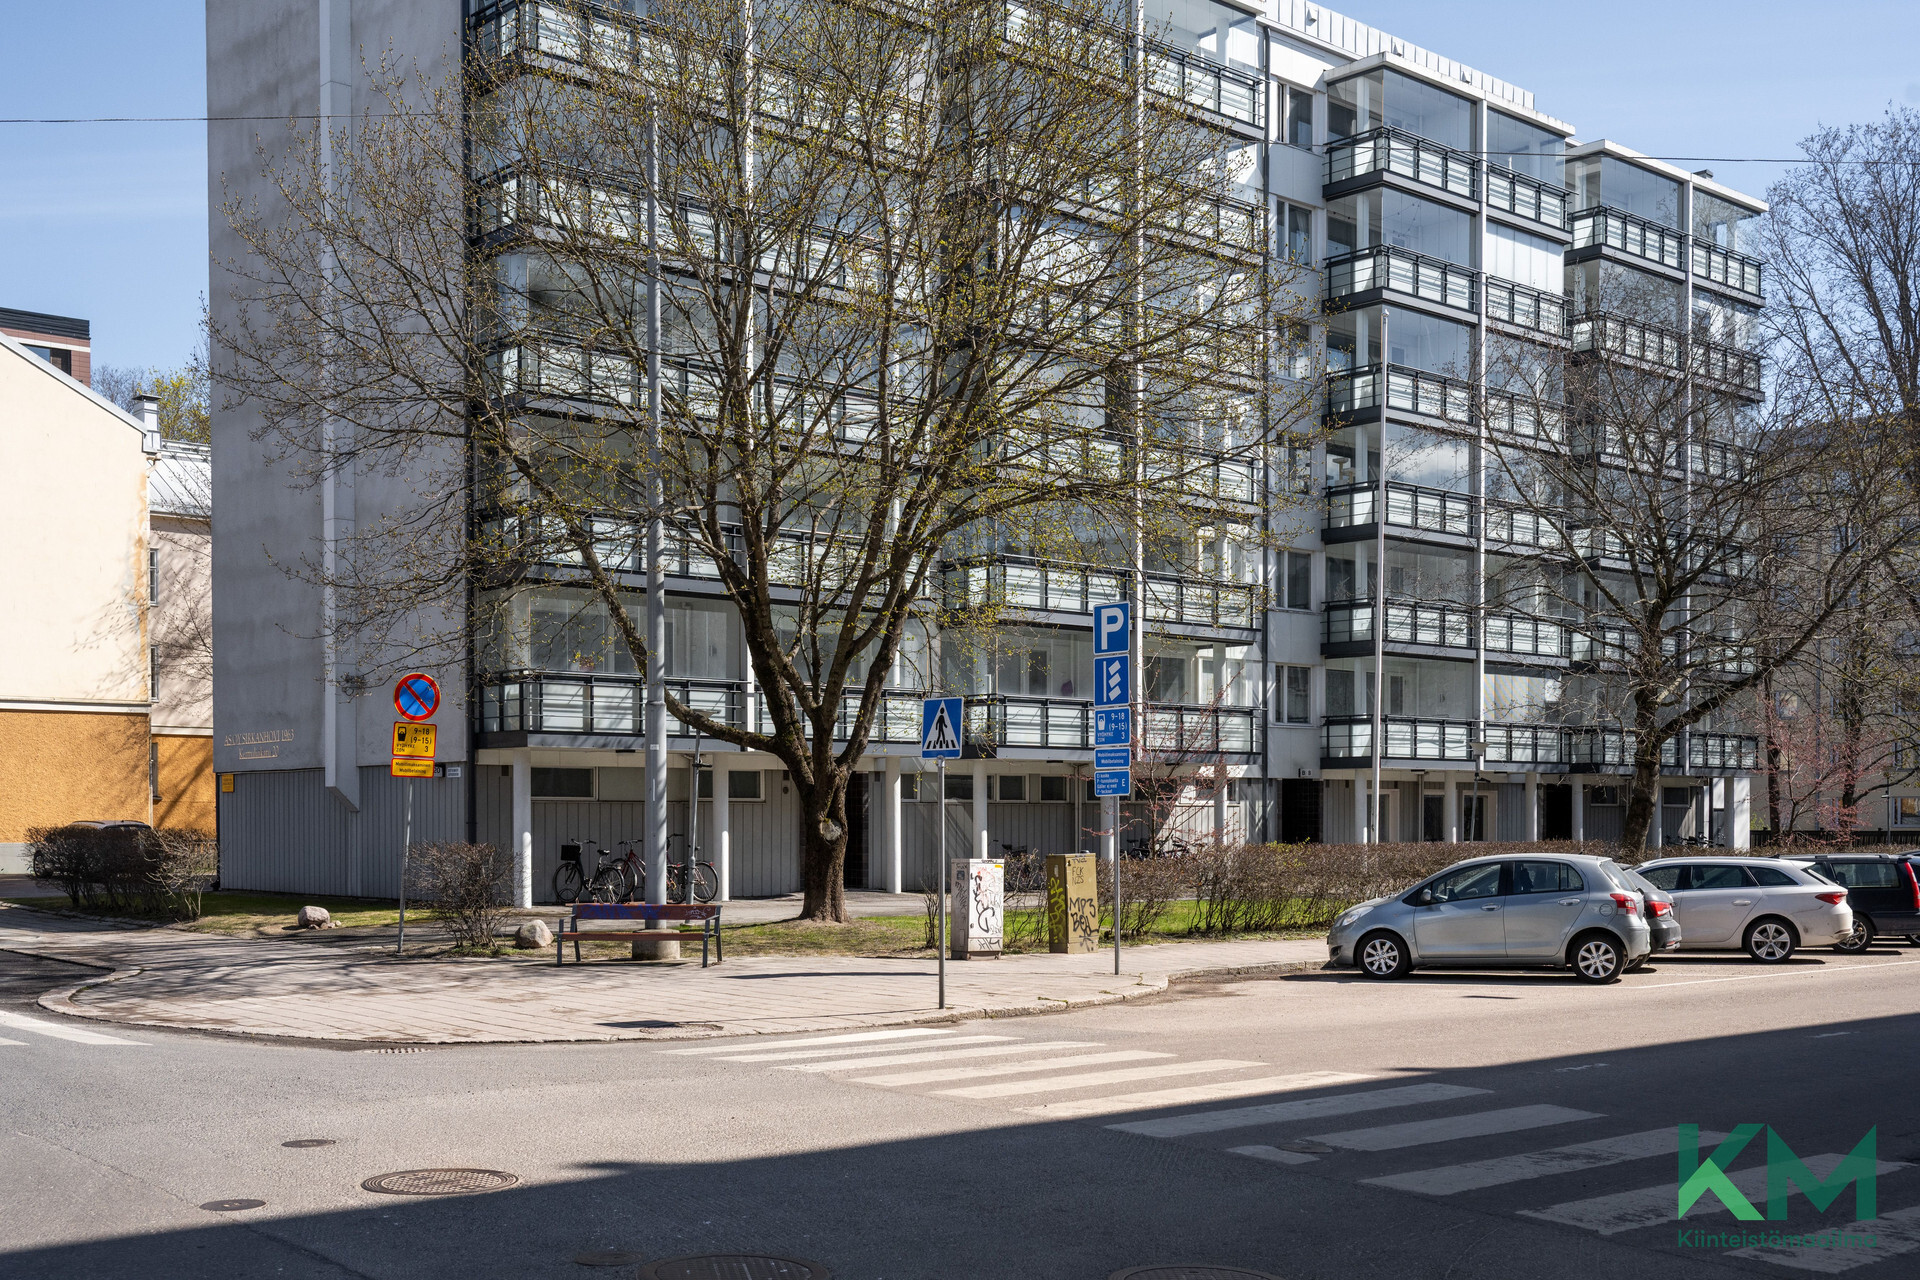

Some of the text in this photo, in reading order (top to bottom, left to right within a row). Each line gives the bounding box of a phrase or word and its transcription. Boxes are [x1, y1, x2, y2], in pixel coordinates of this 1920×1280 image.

[1101, 607, 1124, 650] P
[1109, 722, 1127, 730] (9-15)
[410, 736, 432, 744] (9-15)
[1069, 897, 1096, 918] MP3
